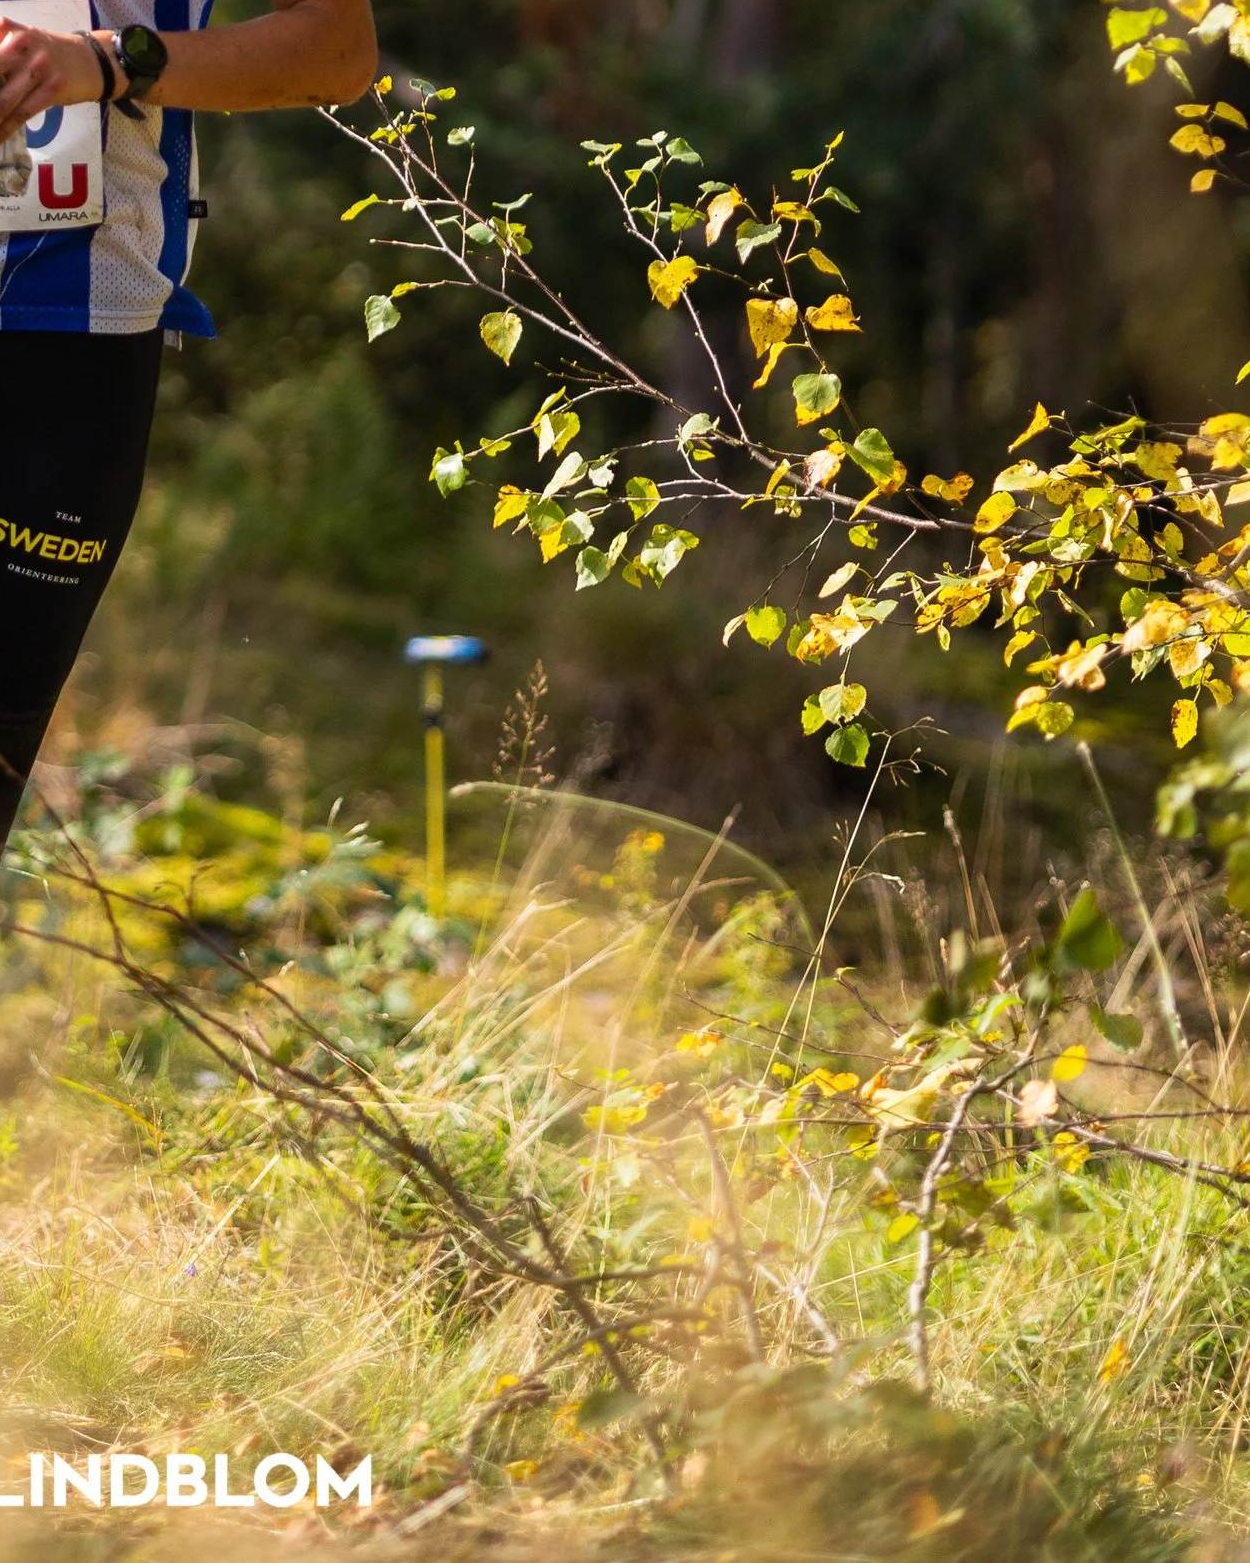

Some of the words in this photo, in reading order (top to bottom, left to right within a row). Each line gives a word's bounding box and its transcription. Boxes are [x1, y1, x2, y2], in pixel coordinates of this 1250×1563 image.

[38, 211, 89, 222] UMARA
[55, 510, 82, 523] TEAM
[7, 563, 80, 585] ORIENTEERING
